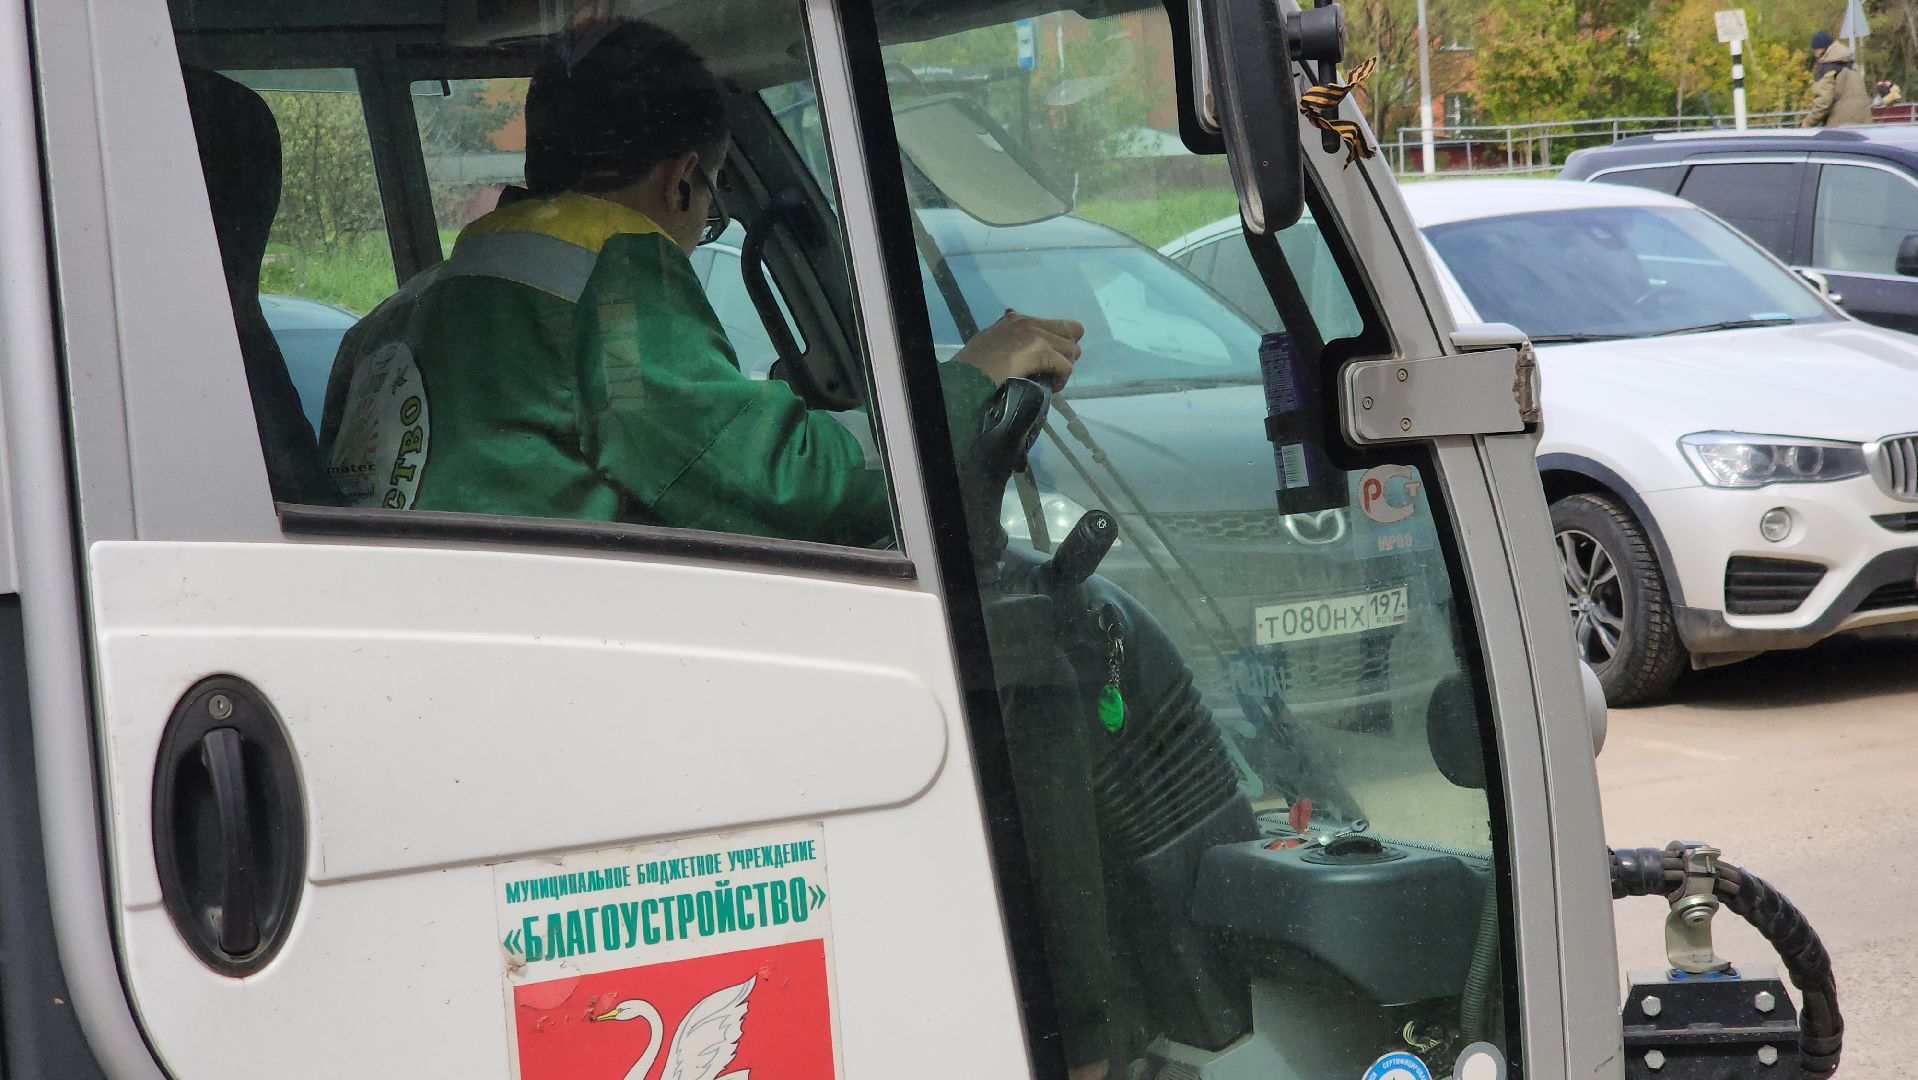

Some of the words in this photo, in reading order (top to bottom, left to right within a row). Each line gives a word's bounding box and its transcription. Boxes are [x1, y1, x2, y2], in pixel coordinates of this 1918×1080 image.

[1370, 591, 1401, 616] 197
[505, 865, 631, 904] МУНИЦИПАЛЬНОЕ
[636, 852, 723, 884] БЮДЖЕТНОЕ
[727, 839, 817, 872] УЧРЕЖДЕНИЕ
[503, 876, 827, 963] «БЛАГОУСТРОЙСТВО»
